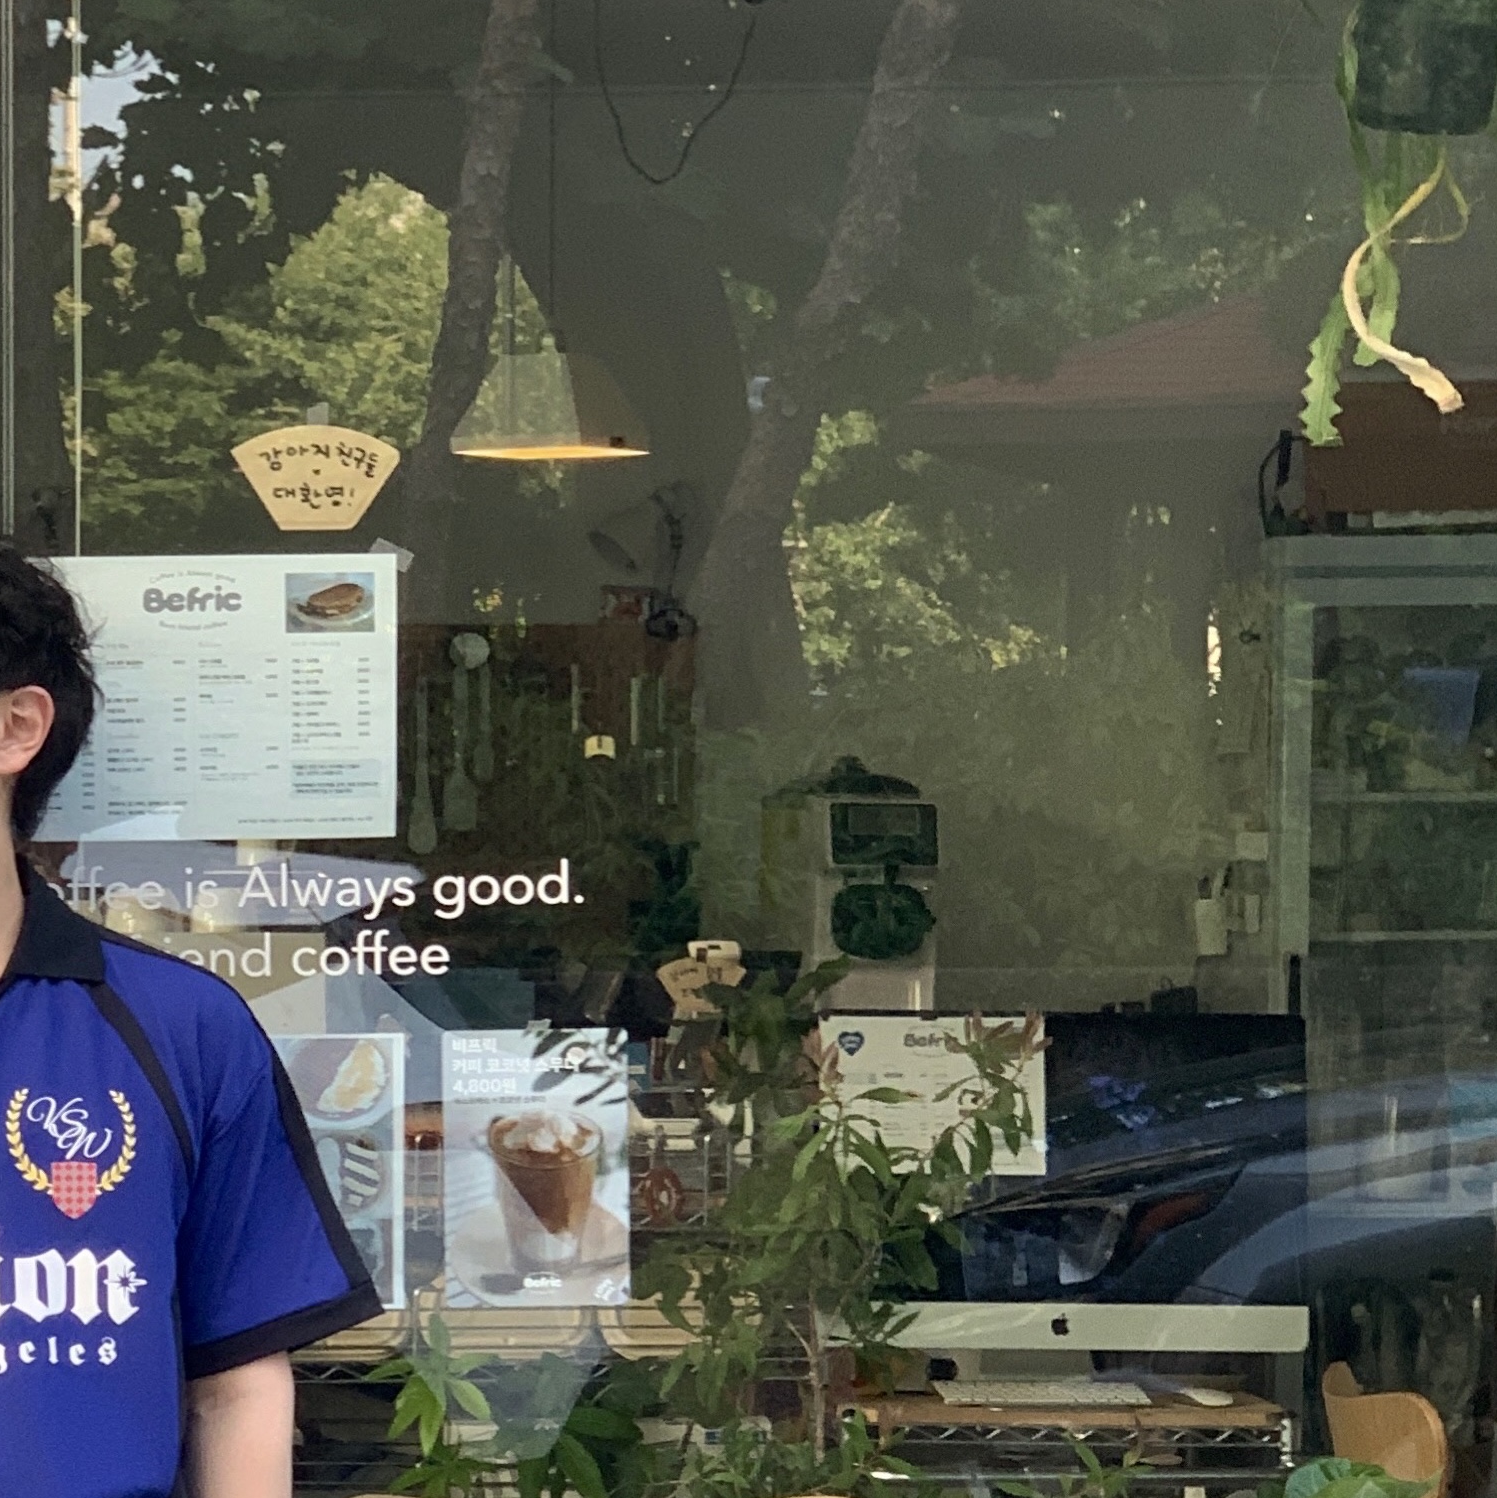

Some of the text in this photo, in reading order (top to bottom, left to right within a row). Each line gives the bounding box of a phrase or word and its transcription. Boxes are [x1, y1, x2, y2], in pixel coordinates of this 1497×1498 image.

[143, 585, 243, 614] Befric
[47, 858, 585, 920] ffee is Always good.
[291, 929, 451, 977] coffee
[452, 1077, 517, 1096] 4,800원
